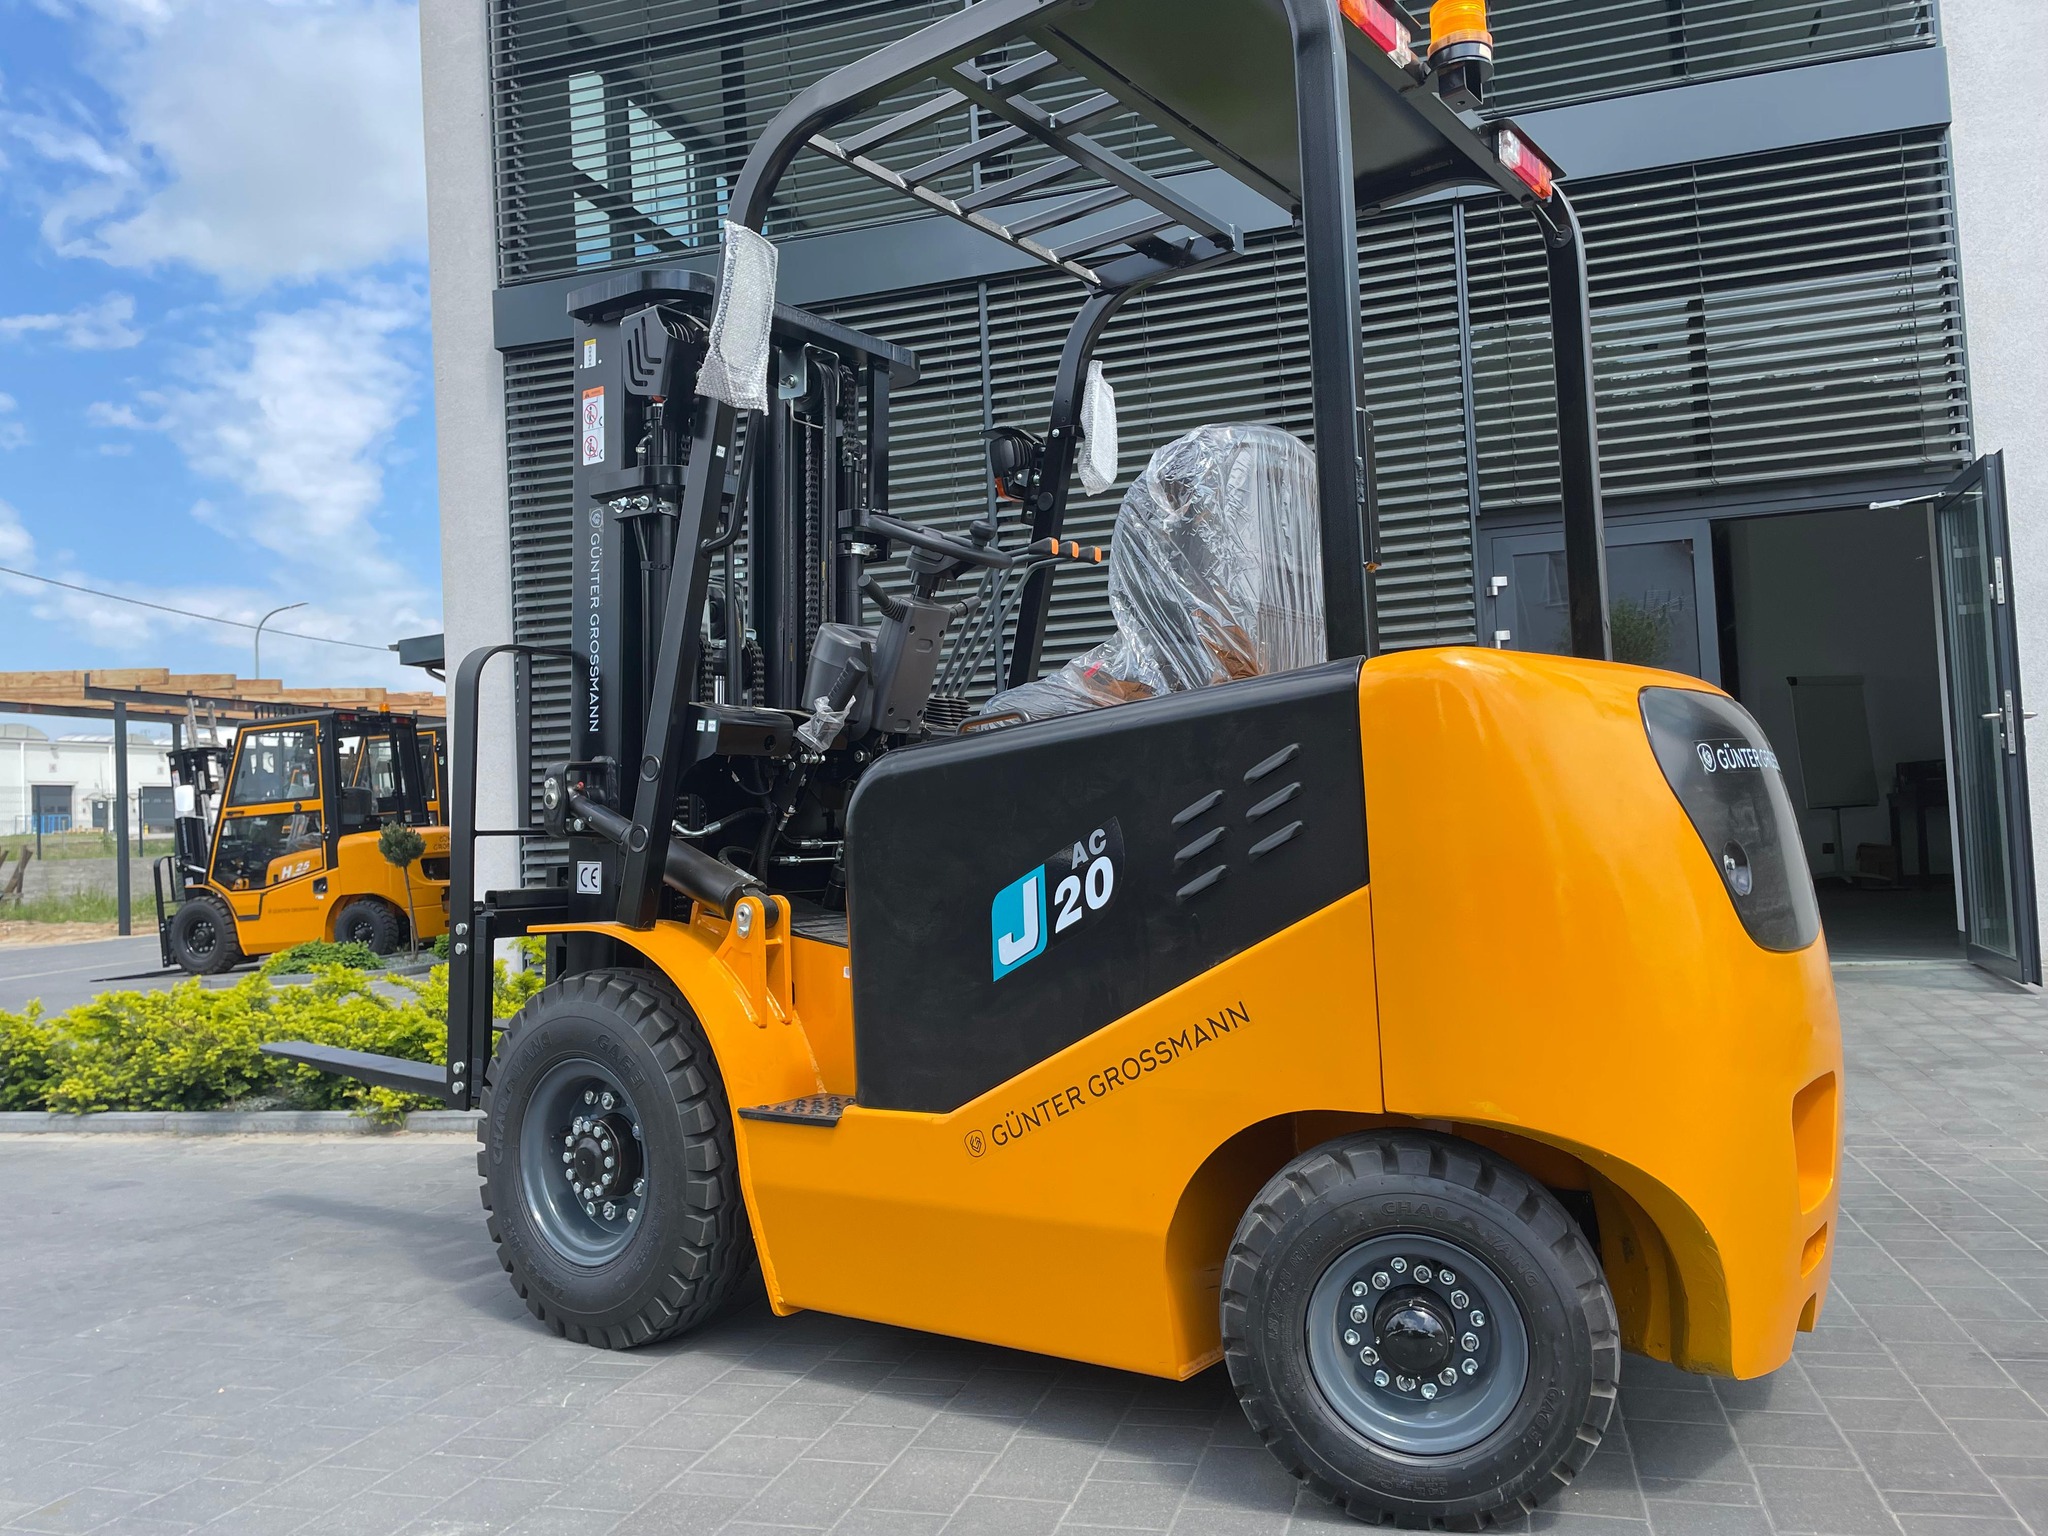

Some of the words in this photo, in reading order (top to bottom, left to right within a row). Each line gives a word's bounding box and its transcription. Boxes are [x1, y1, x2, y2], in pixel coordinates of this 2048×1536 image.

[588, 533, 603, 609] GÜNTER
[588, 613, 600, 733] GROSSMANN
[1716, 743, 1761, 770] GÜNTER
[281, 864, 293, 880] H
[295, 860, 311, 873] 25
[580, 867, 598, 888] CE
[1071, 828, 1107, 870] AC
[997, 875, 1039, 966] J
[1053, 855, 1114, 934] 20
[990, 1085, 1086, 1147] GÜNTER
[1088, 1000, 1251, 1098] GROSSMANN
[1380, 1201, 1449, 1221] CHAO
[1481, 1228, 1540, 1288] YANG
